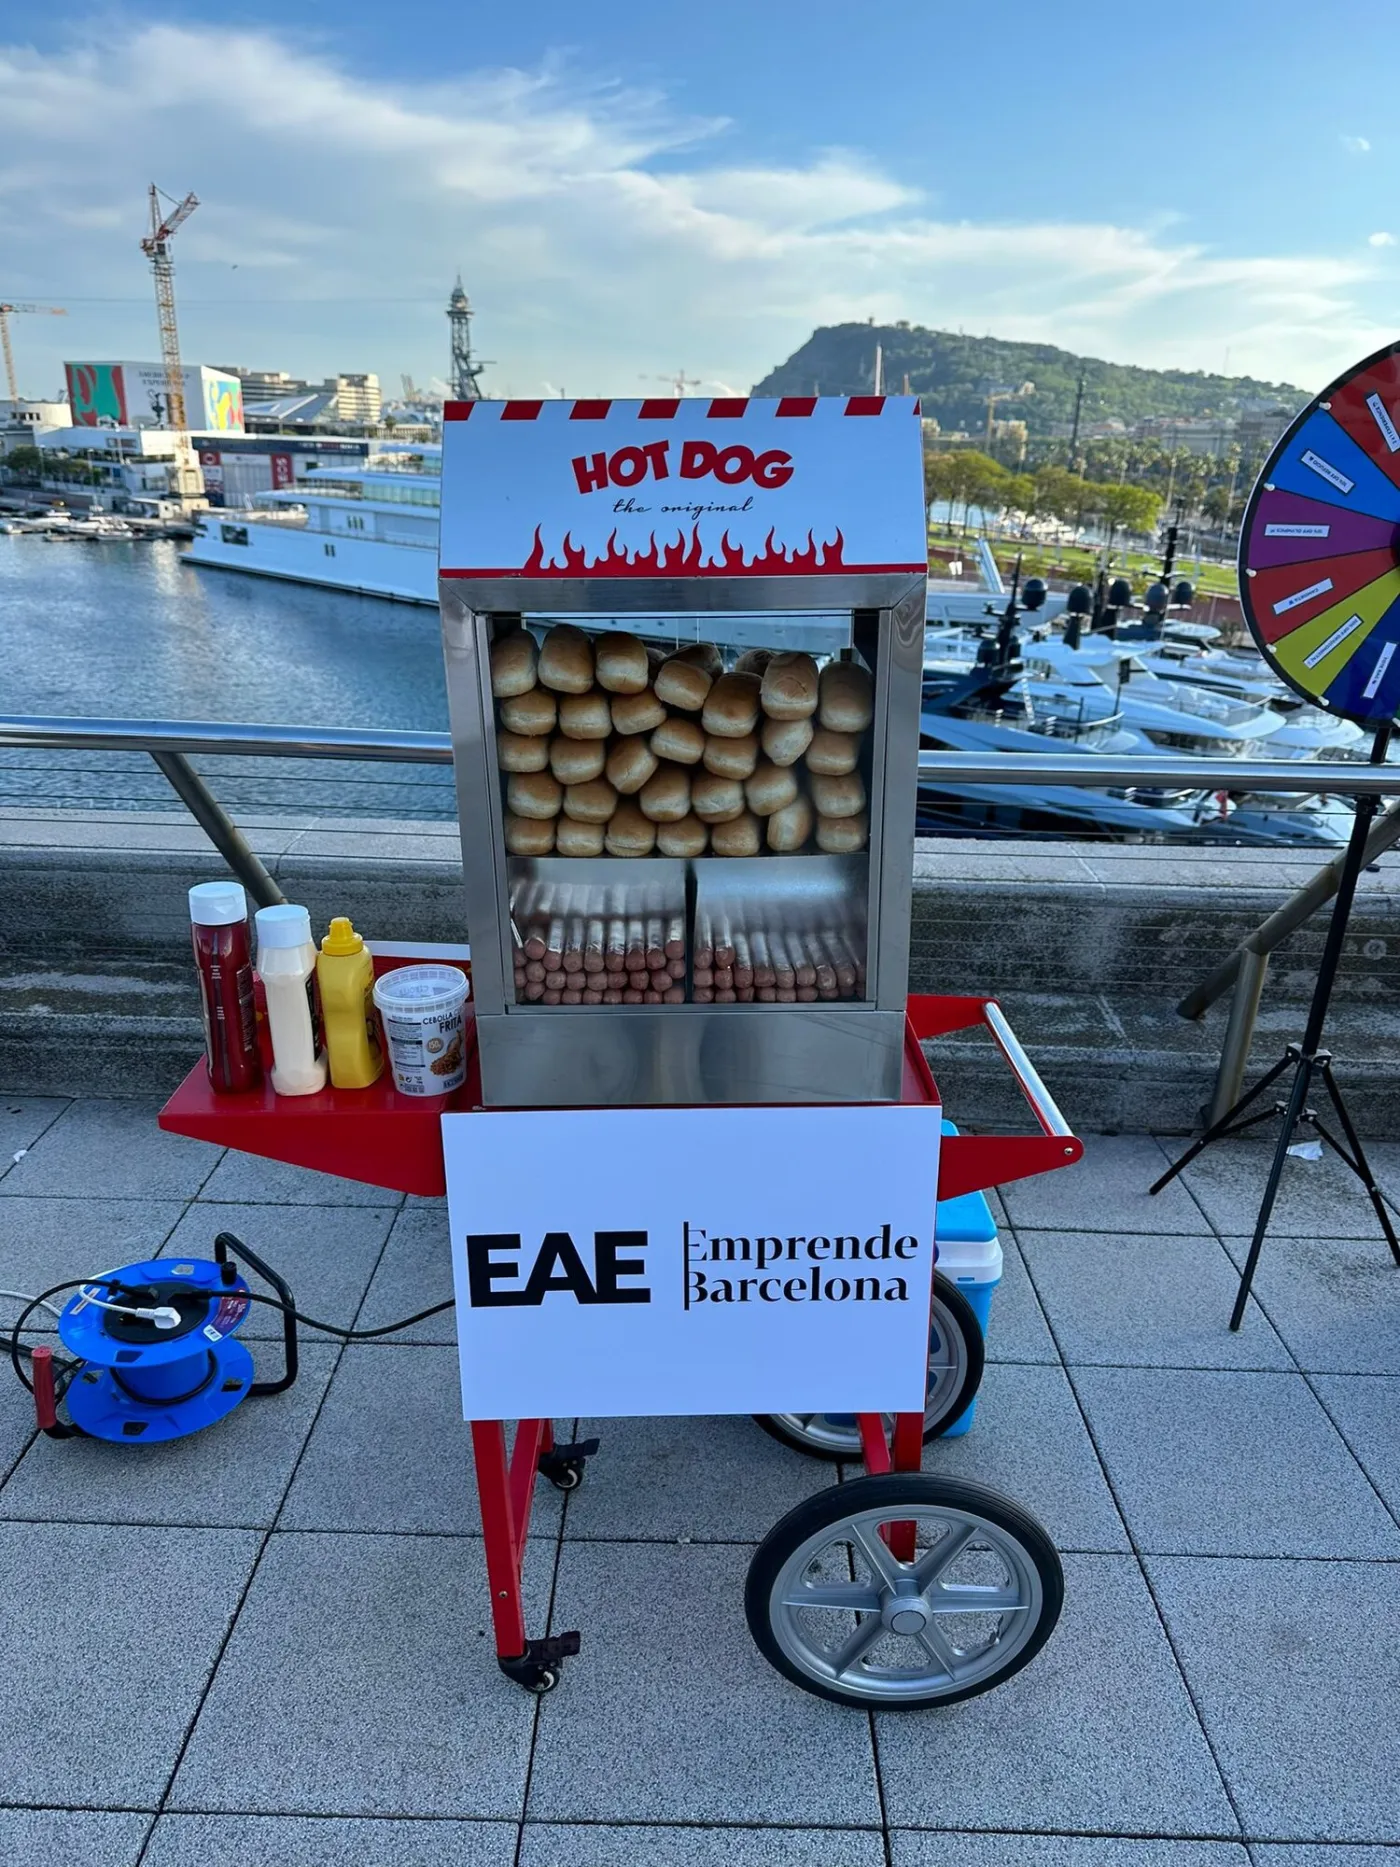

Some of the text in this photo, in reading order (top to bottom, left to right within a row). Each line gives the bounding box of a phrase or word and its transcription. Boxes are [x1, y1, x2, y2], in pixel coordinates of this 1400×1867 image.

[572, 439, 795, 495] HOT DOG
[613, 497, 753, 521] the original
[422, 1011, 453, 1025] CEBOLLA
[439, 1015, 462, 1034] FRITA
[688, 1224, 918, 1270] Emprende
[466, 1230, 651, 1308] EAE
[688, 1266, 908, 1304] Barcelona
